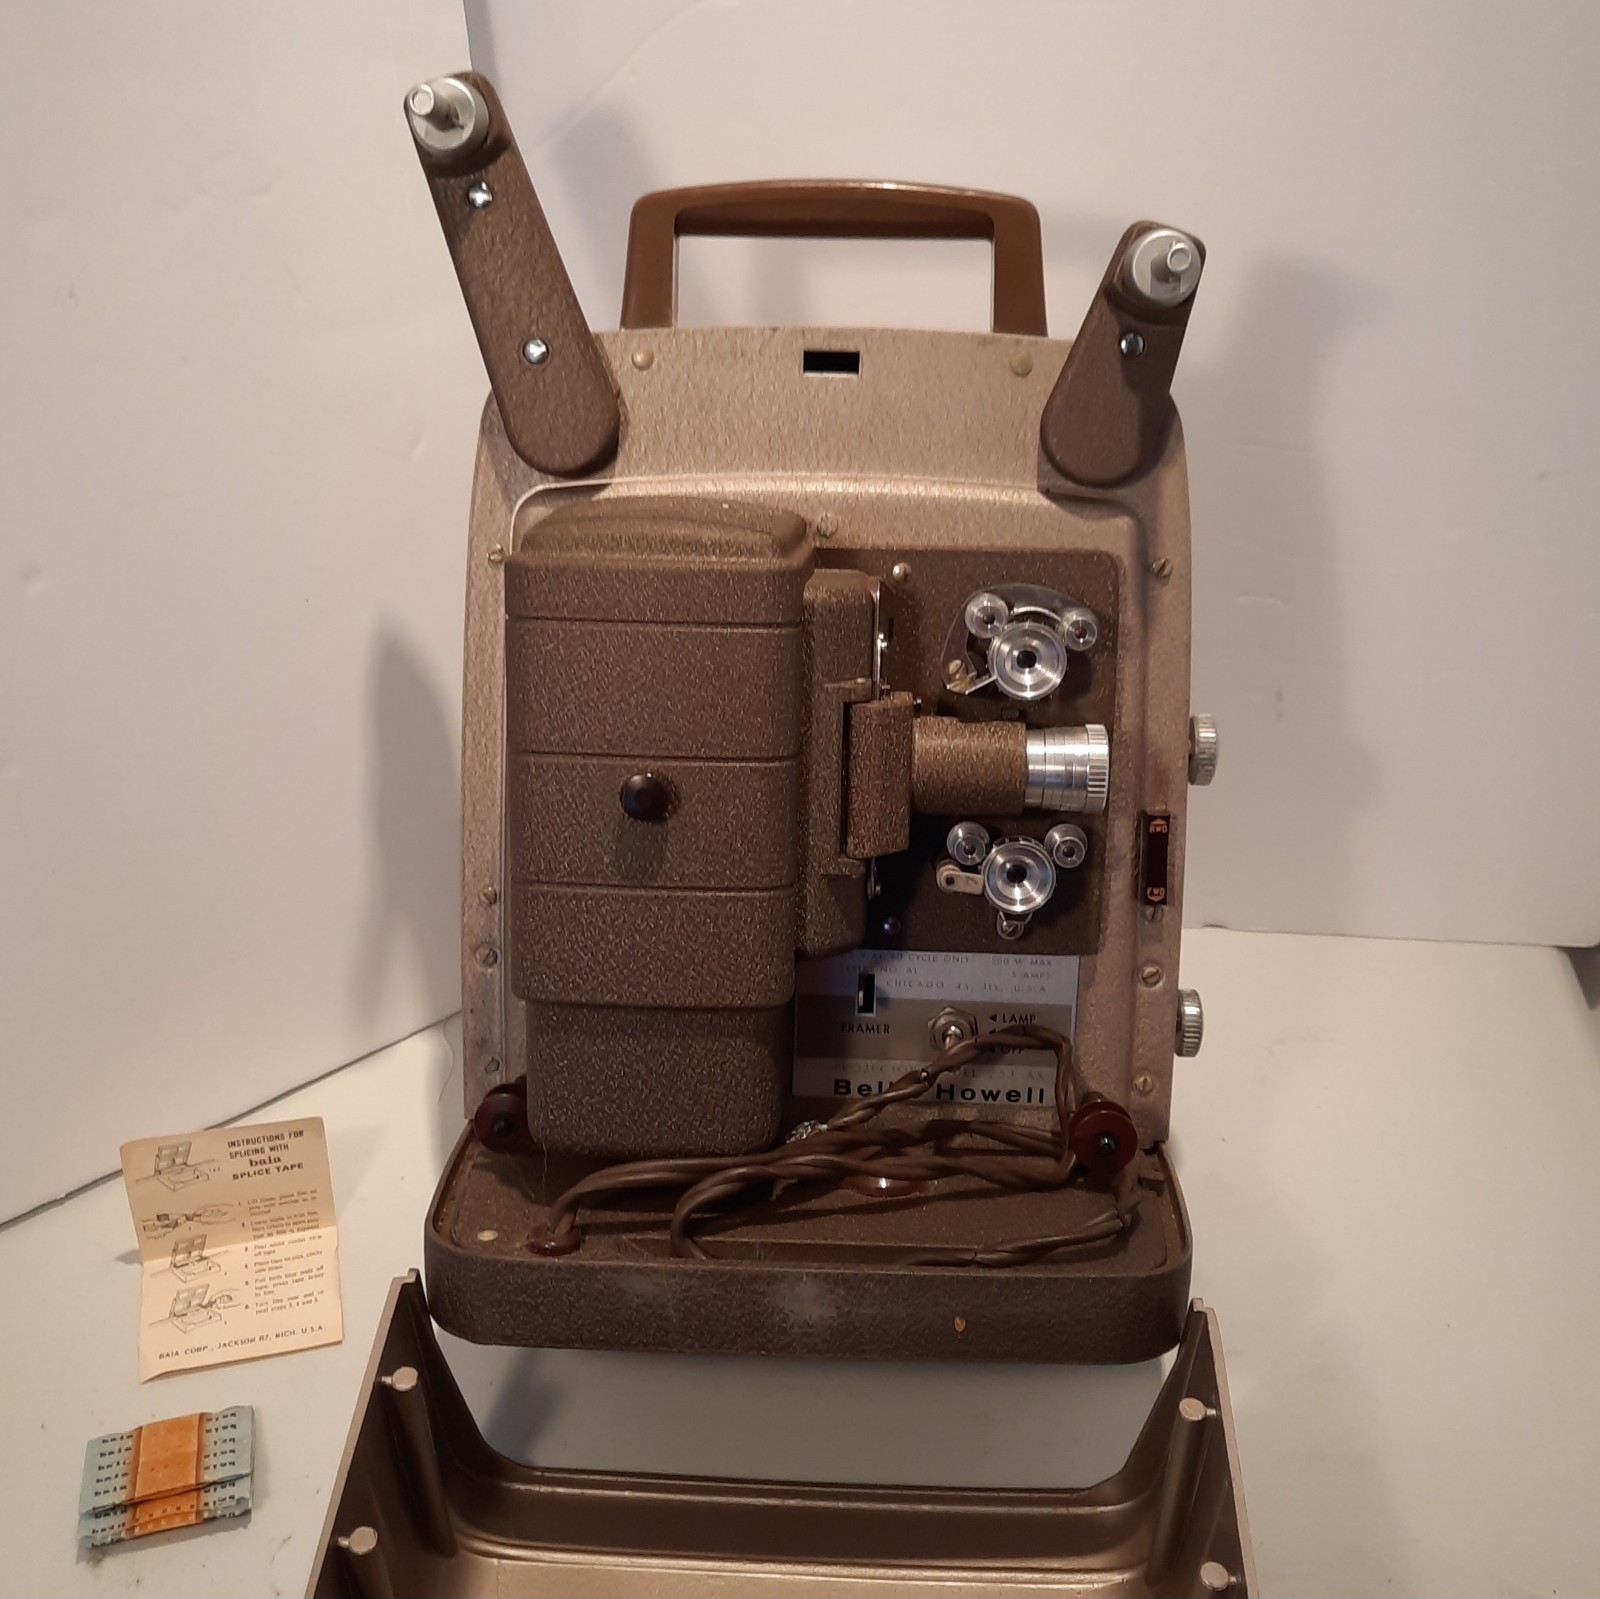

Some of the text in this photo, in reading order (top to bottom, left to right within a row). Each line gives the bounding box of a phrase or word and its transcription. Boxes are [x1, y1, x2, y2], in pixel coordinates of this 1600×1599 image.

[1149, 825, 1168, 834] RWD
[909, 954, 936, 963] CYCLE
[943, 955, 970, 964] ONLY
[886, 980, 945, 989] CHICAGO
[1002, 1013, 1036, 1025] LAMP
[841, 1022, 891, 1034] FRAMER
[936, 1084, 1045, 1105] Howell
[228, 1129, 304, 1148] INSTRUCTIONS FOR
[229, 1143, 289, 1160] SPLICING WITH
[232, 1162, 304, 1180] SPLICE TAPE
